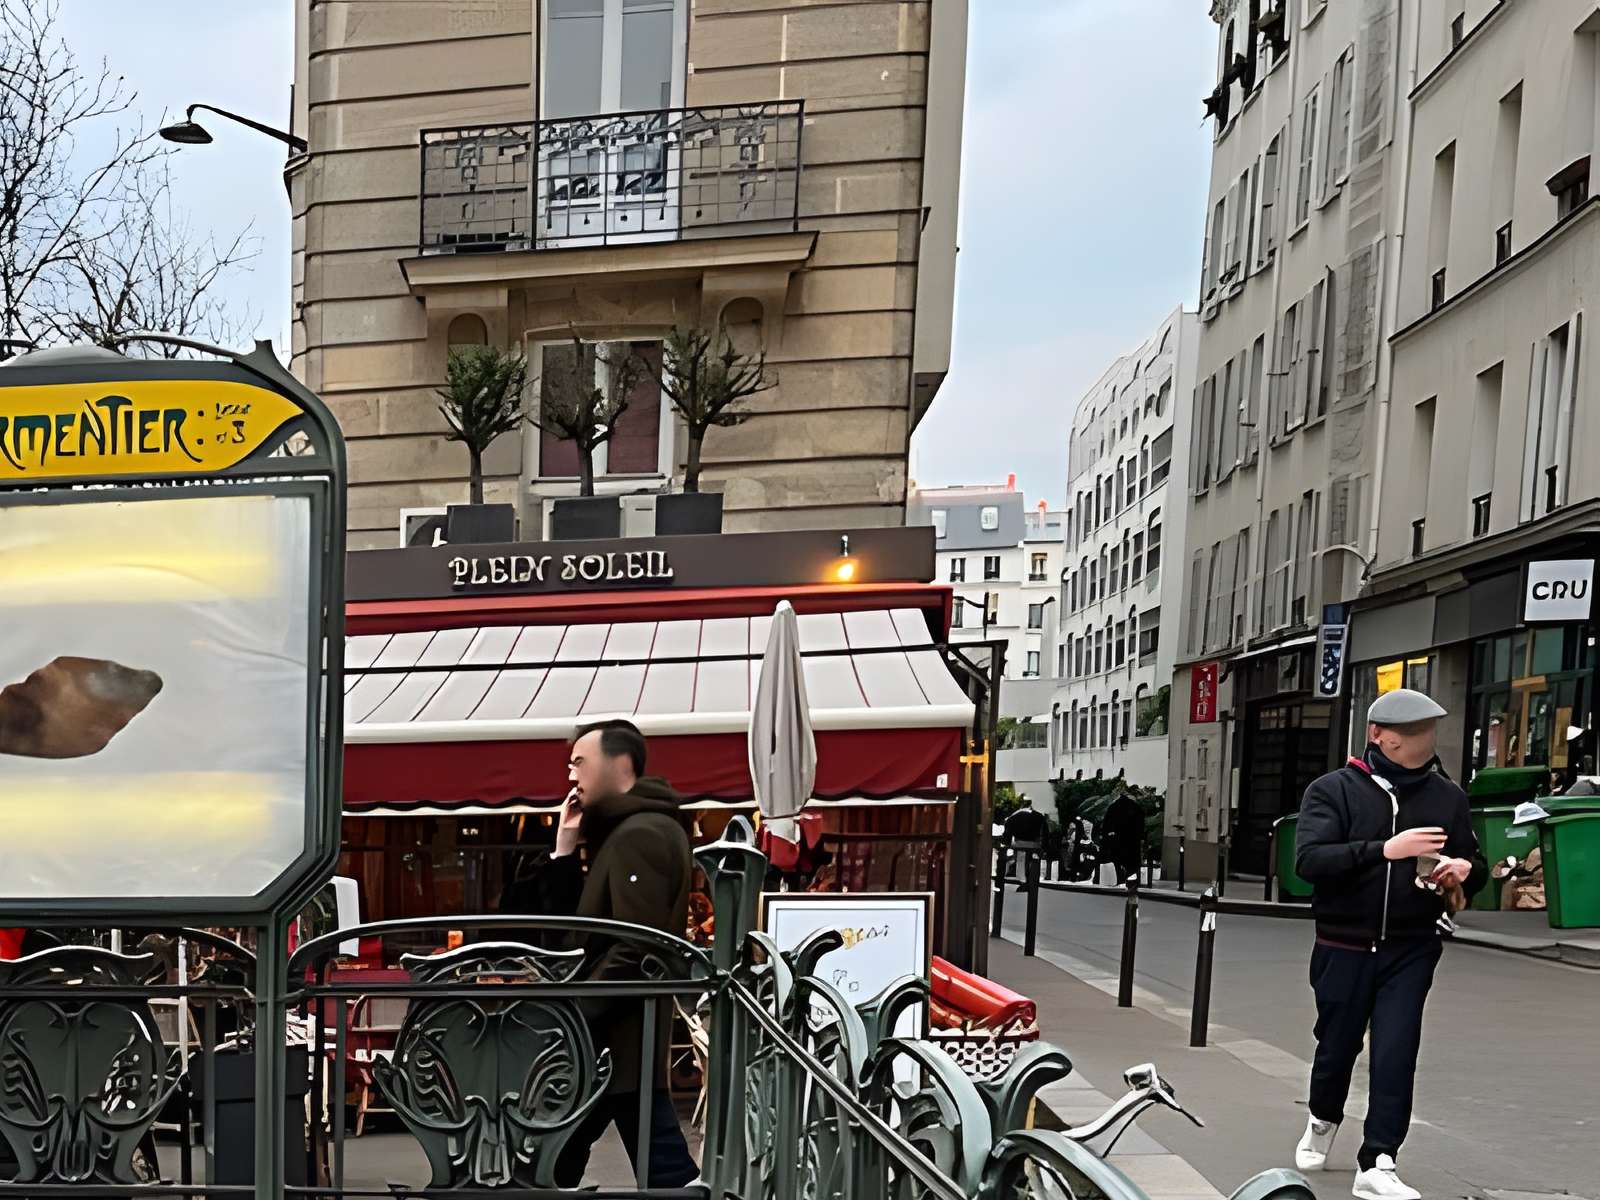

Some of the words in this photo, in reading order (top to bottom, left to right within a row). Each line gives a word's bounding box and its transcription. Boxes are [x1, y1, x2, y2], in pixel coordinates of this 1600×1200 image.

[448, 555, 552, 586] PLEIN
[560, 550, 674, 581] SOLEIL
[1532, 579, 1588, 601] CRU
